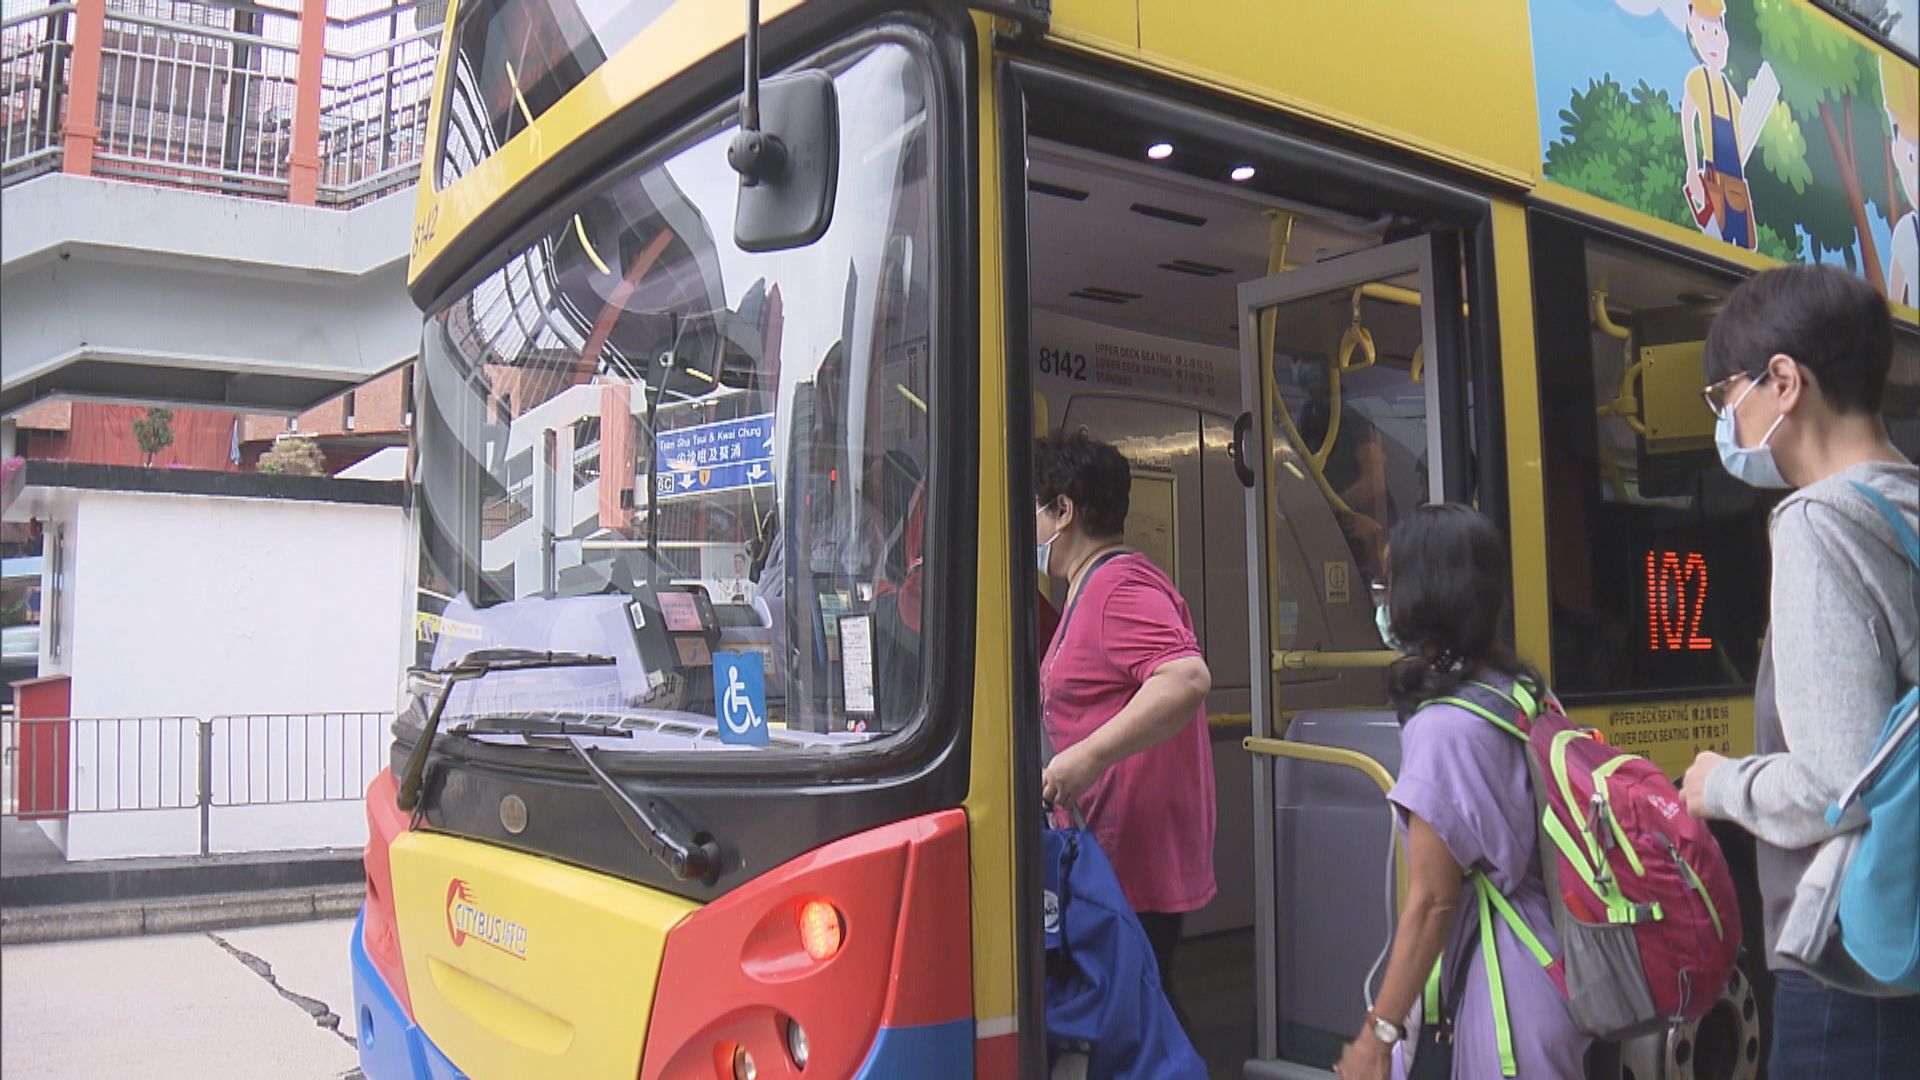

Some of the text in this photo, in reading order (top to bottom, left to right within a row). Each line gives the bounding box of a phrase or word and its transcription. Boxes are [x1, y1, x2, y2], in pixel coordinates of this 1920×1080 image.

[1095, 343, 1119, 357] UPPER
[1120, 346, 1139, 360] DECK
[1040, 347, 1087, 381] 8142
[1095, 356, 1120, 370] LOWER
[677, 436, 690, 448] Sha
[708, 432, 715, 442] &
[717, 429, 735, 440] Kwai
[738, 426, 761, 438] Chung
[1646, 550, 1713, 650] 102
[1609, 711, 1635, 727] UPPER
[1636, 709, 1656, 724] DECK
[1658, 707, 1689, 723] SEATING
[1609, 731, 1637, 747] LOWER
[1638, 729, 1658, 744] DECK
[1660, 727, 1689, 742] SEATING
[455, 903, 502, 944] CITYBUS
